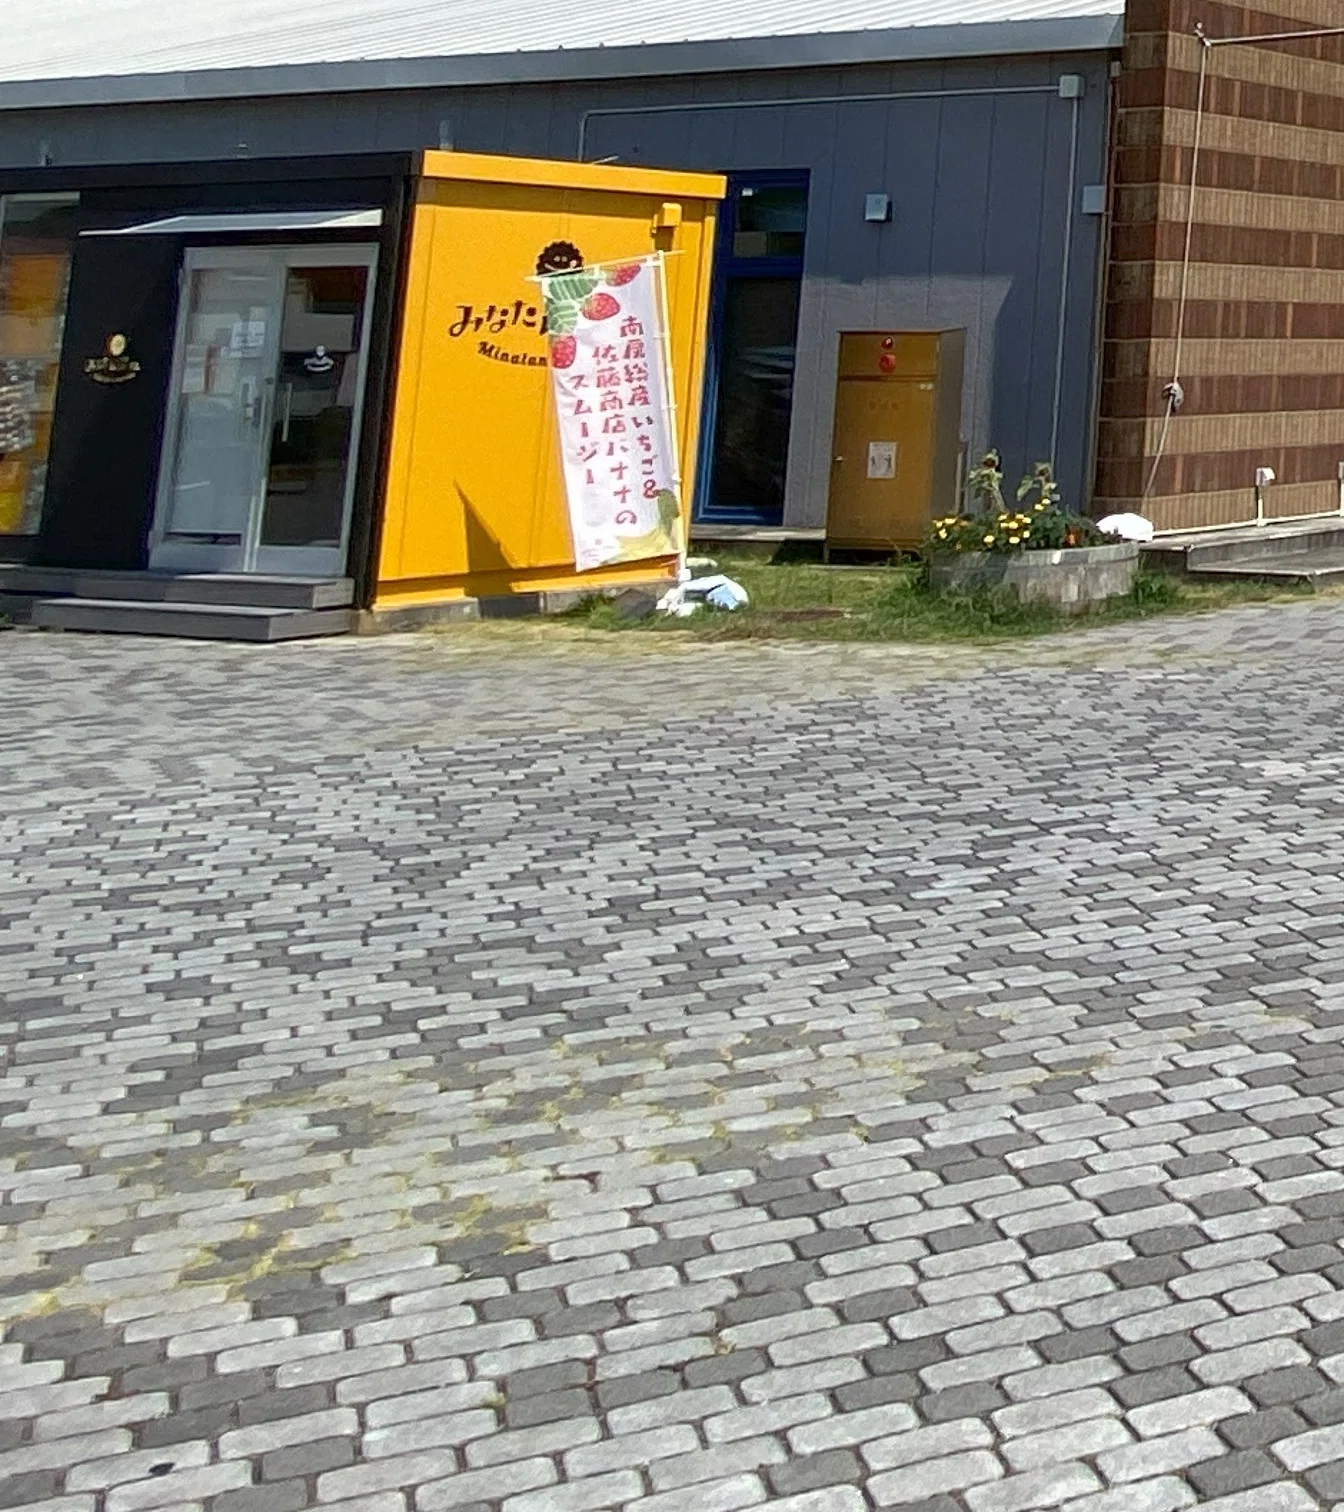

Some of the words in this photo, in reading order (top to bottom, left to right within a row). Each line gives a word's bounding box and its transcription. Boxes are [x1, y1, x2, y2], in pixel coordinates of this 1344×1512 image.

[448, 300, 547, 337] みなた
[569, 374, 598, 484] スムージー
